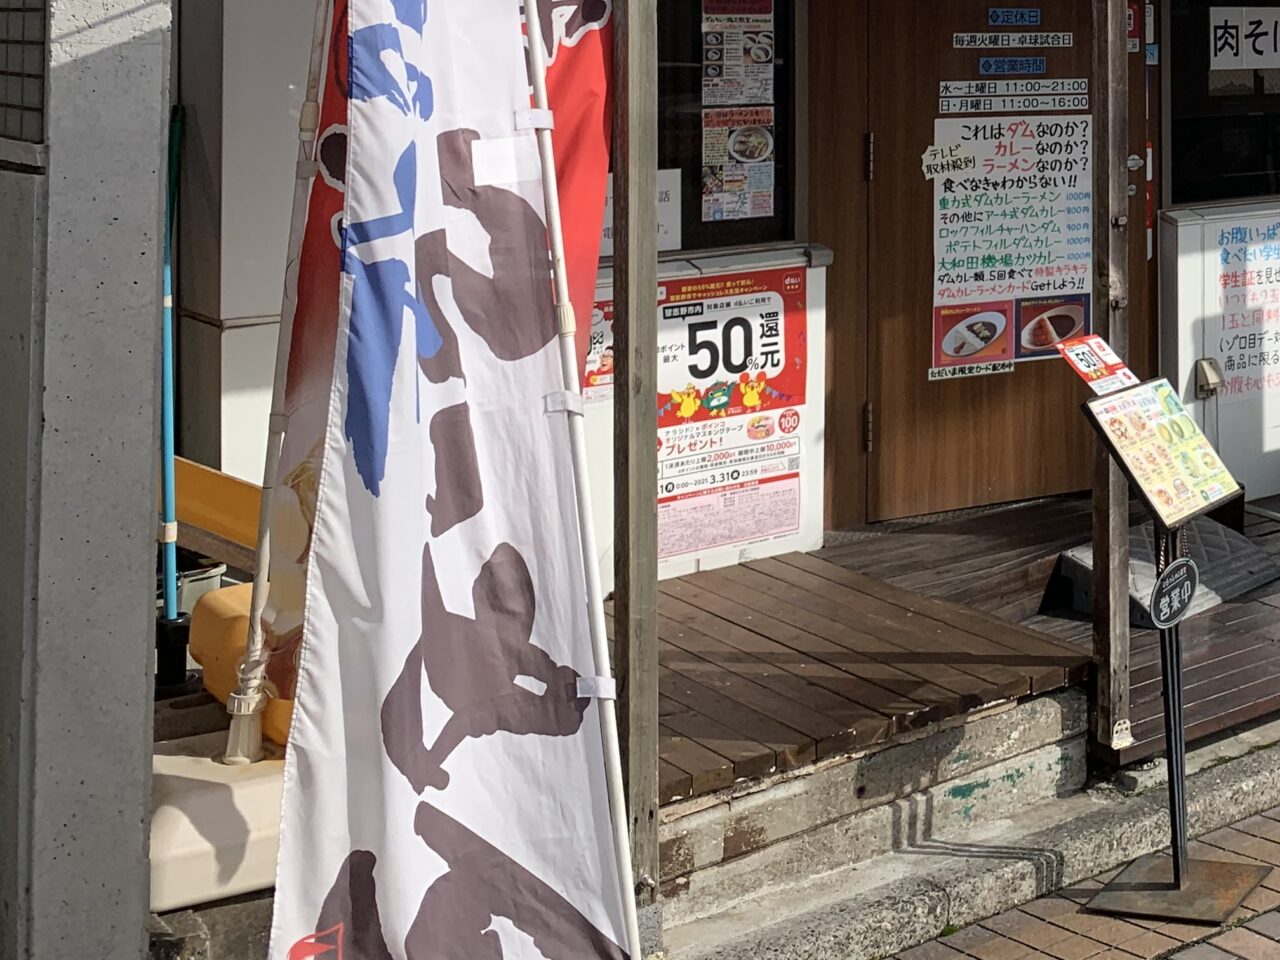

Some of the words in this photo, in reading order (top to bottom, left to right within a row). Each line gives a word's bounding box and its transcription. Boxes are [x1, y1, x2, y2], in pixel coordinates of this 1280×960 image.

[1001, 11, 1039, 24] 定休日
[954, 34, 1072, 47] 毎週火曜日・卓球試合日
[993, 58, 1045, 73] 営業時間
[961, 119, 1089, 141] これはダムなのか？
[929, 143, 962, 161] テレビ
[994, 139, 1089, 157] カレーなのか？
[925, 155, 976, 176] 取材殺到
[982, 156, 1089, 174] ラーメンなのか？
[941, 174, 1078, 194] 食べなきゃわからない！！
[938, 191, 1062, 211] 重力式ダムカレーラーメン
[1065, 192, 1091, 201] 1000円
[945, 236, 1063, 254] ポテトフィルダムカレー
[760, 311, 780, 369] 還元
[780, 416, 798, 427] 100
[665, 436, 723, 456] プレゼント！
[1159, 580, 1192, 621] 営業中
